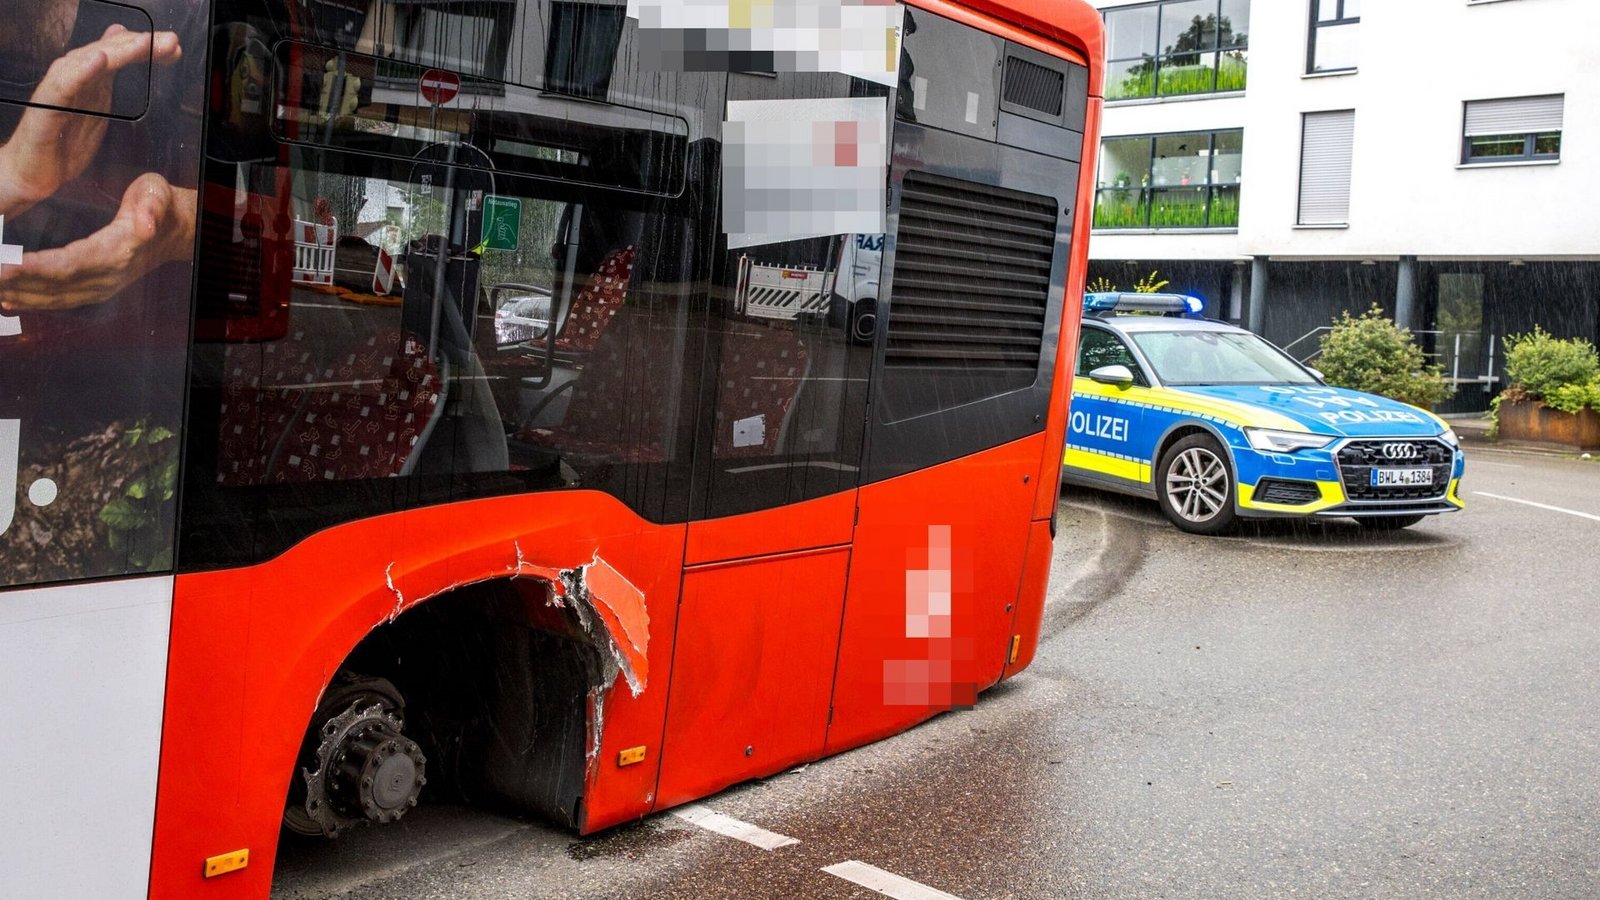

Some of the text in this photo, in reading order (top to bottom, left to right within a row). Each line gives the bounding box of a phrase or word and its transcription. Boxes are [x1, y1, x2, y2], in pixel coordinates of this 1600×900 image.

[1320, 410, 1425, 424] POLIZEI
[1068, 410, 1129, 442] OLIZEI
[1379, 471, 1397, 484] BWL
[1410, 470, 1431, 484] 1384
